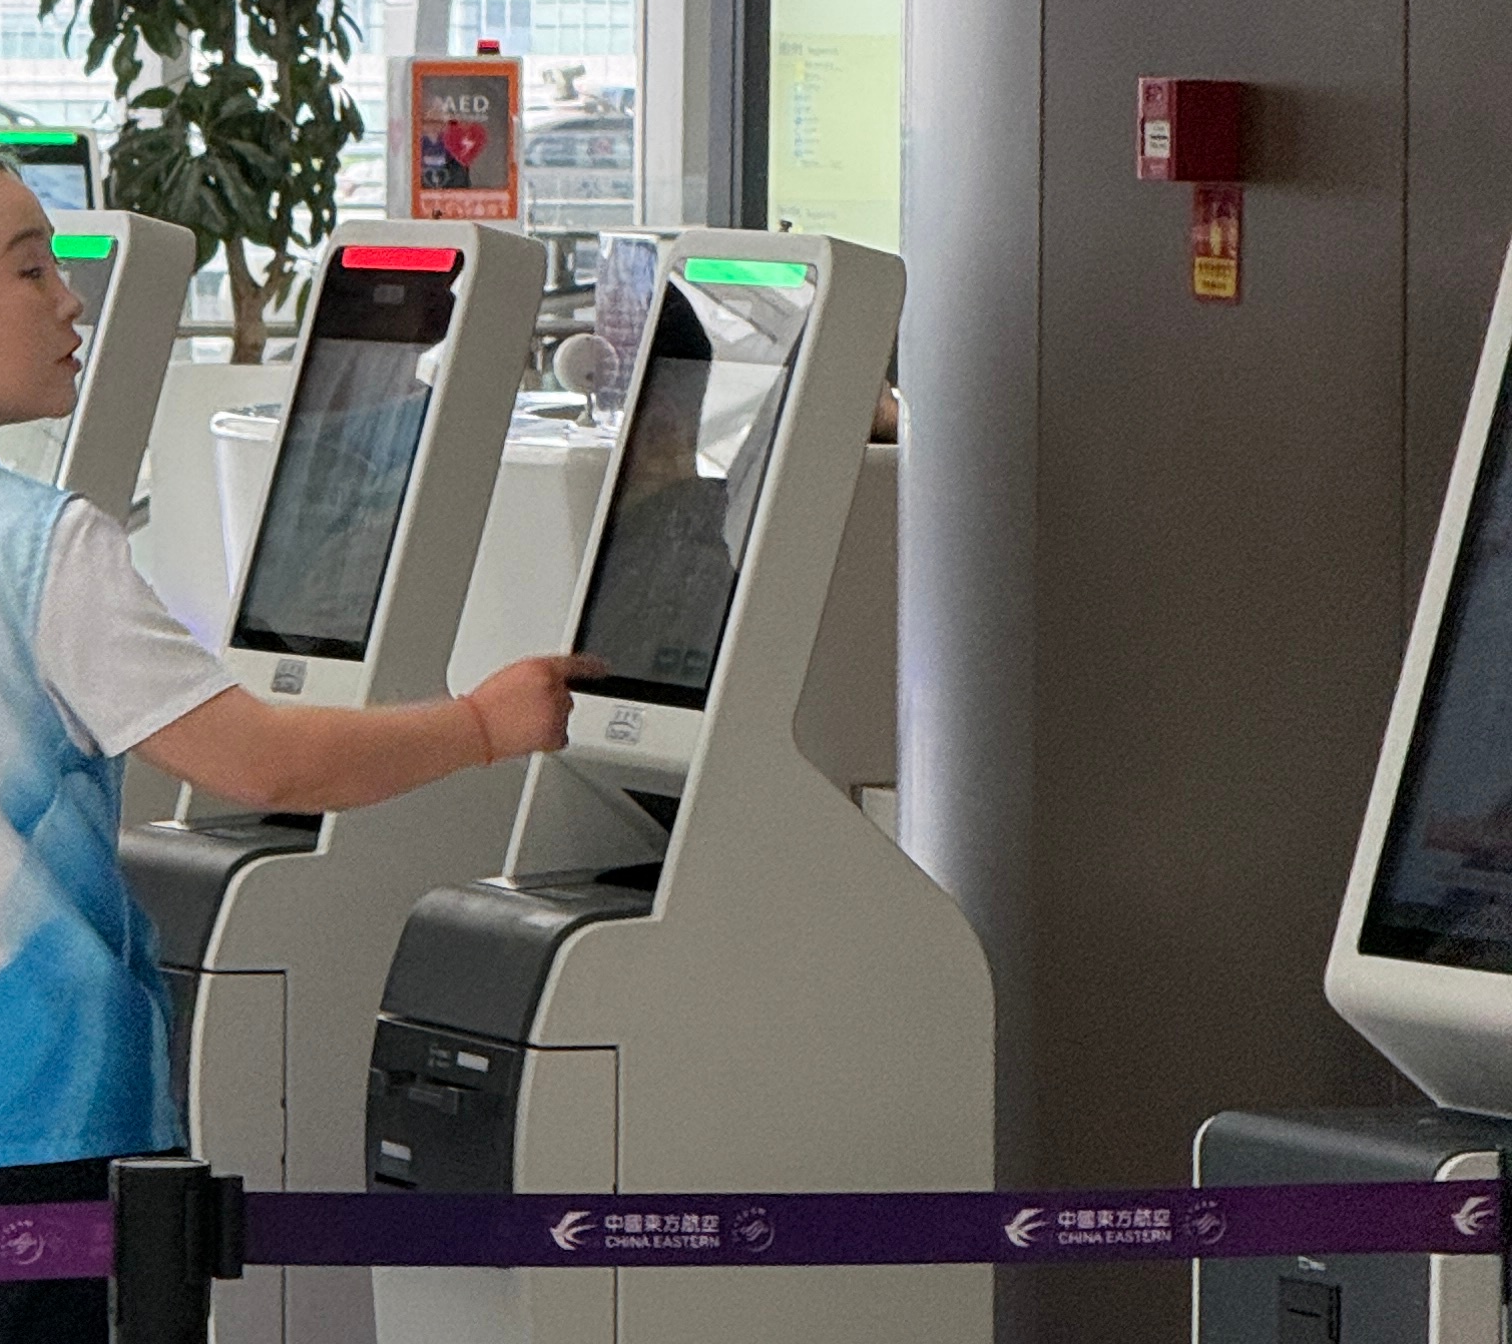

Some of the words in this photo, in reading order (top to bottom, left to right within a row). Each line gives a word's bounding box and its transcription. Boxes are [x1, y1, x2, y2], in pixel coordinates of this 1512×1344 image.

[441, 94, 490, 114] AED
[605, 1234, 651, 1250] CHINA
[653, 1234, 720, 1249] EASTERN
[1057, 1229, 1103, 1244] CHINA
[1105, 1228, 1172, 1244] EASTERN
